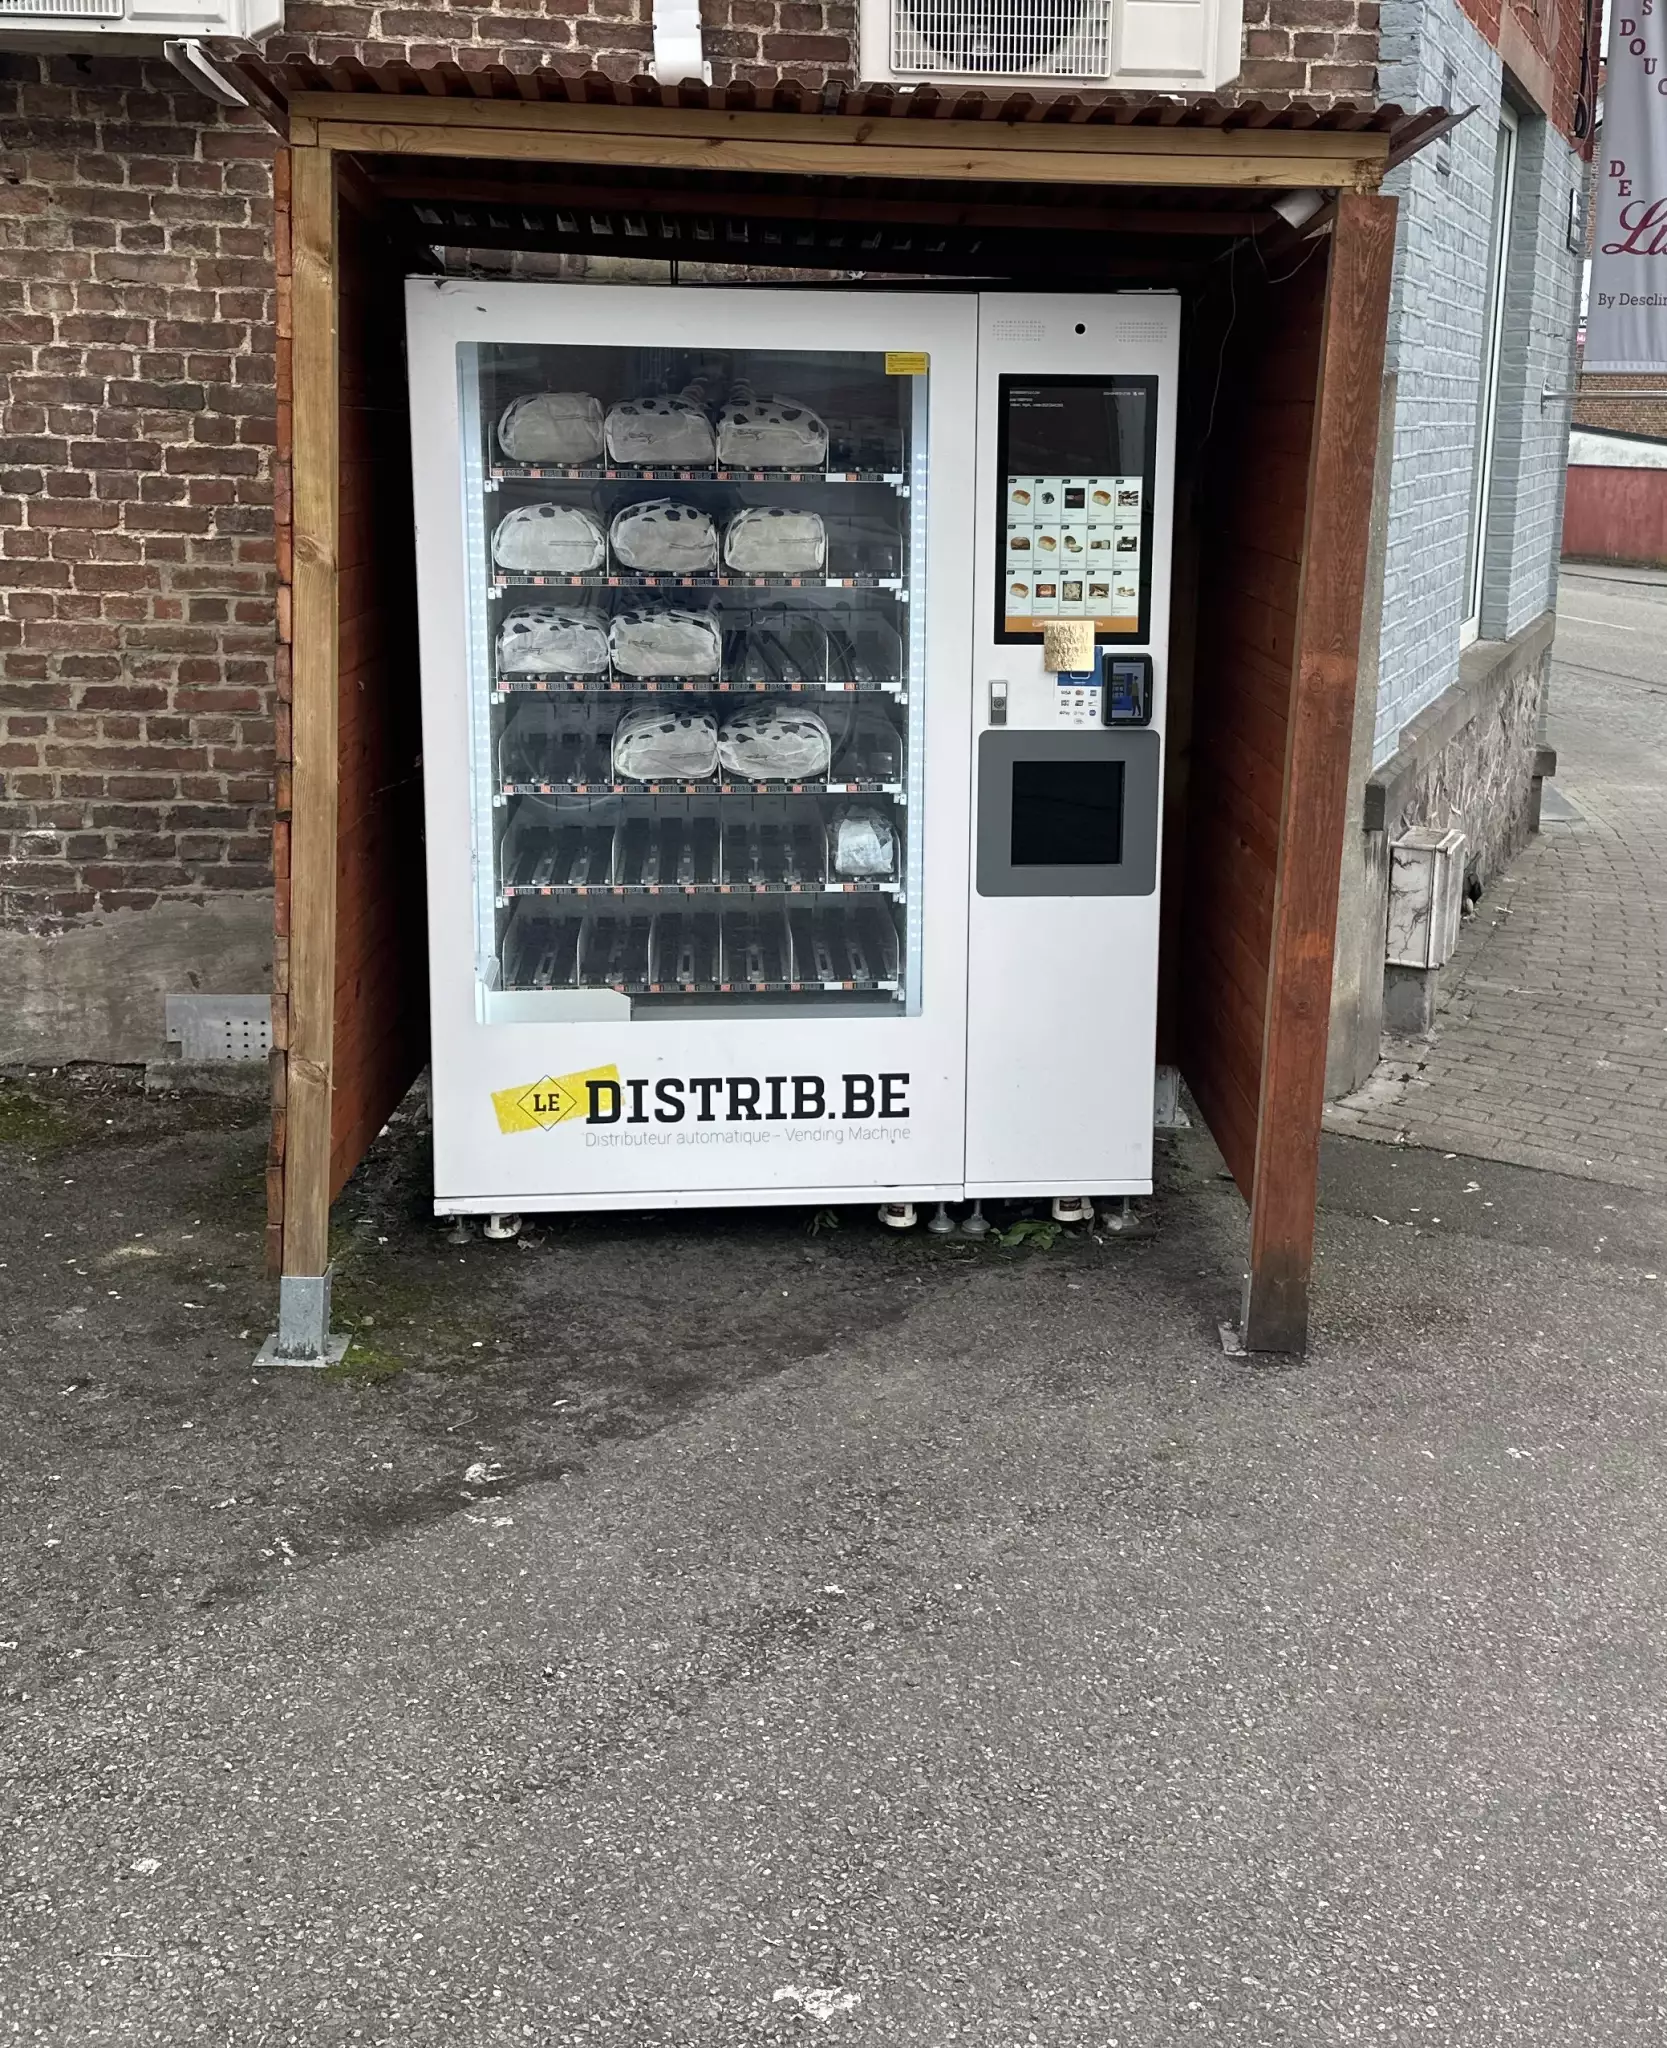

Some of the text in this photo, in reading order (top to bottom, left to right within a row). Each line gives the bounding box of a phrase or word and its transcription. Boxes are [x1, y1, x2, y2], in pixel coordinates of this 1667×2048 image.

[1608, 160, 1633, 197] DE
[1598, 292, 1616, 309] By
[533, 1073, 910, 1124] LE DISTRIB.BE
[585, 1131, 673, 1147] Distributeur
[676, 1129, 771, 1146] automatique
[785, 1127, 844, 1145] Vending
[849, 1125, 911, 1141] Machine
